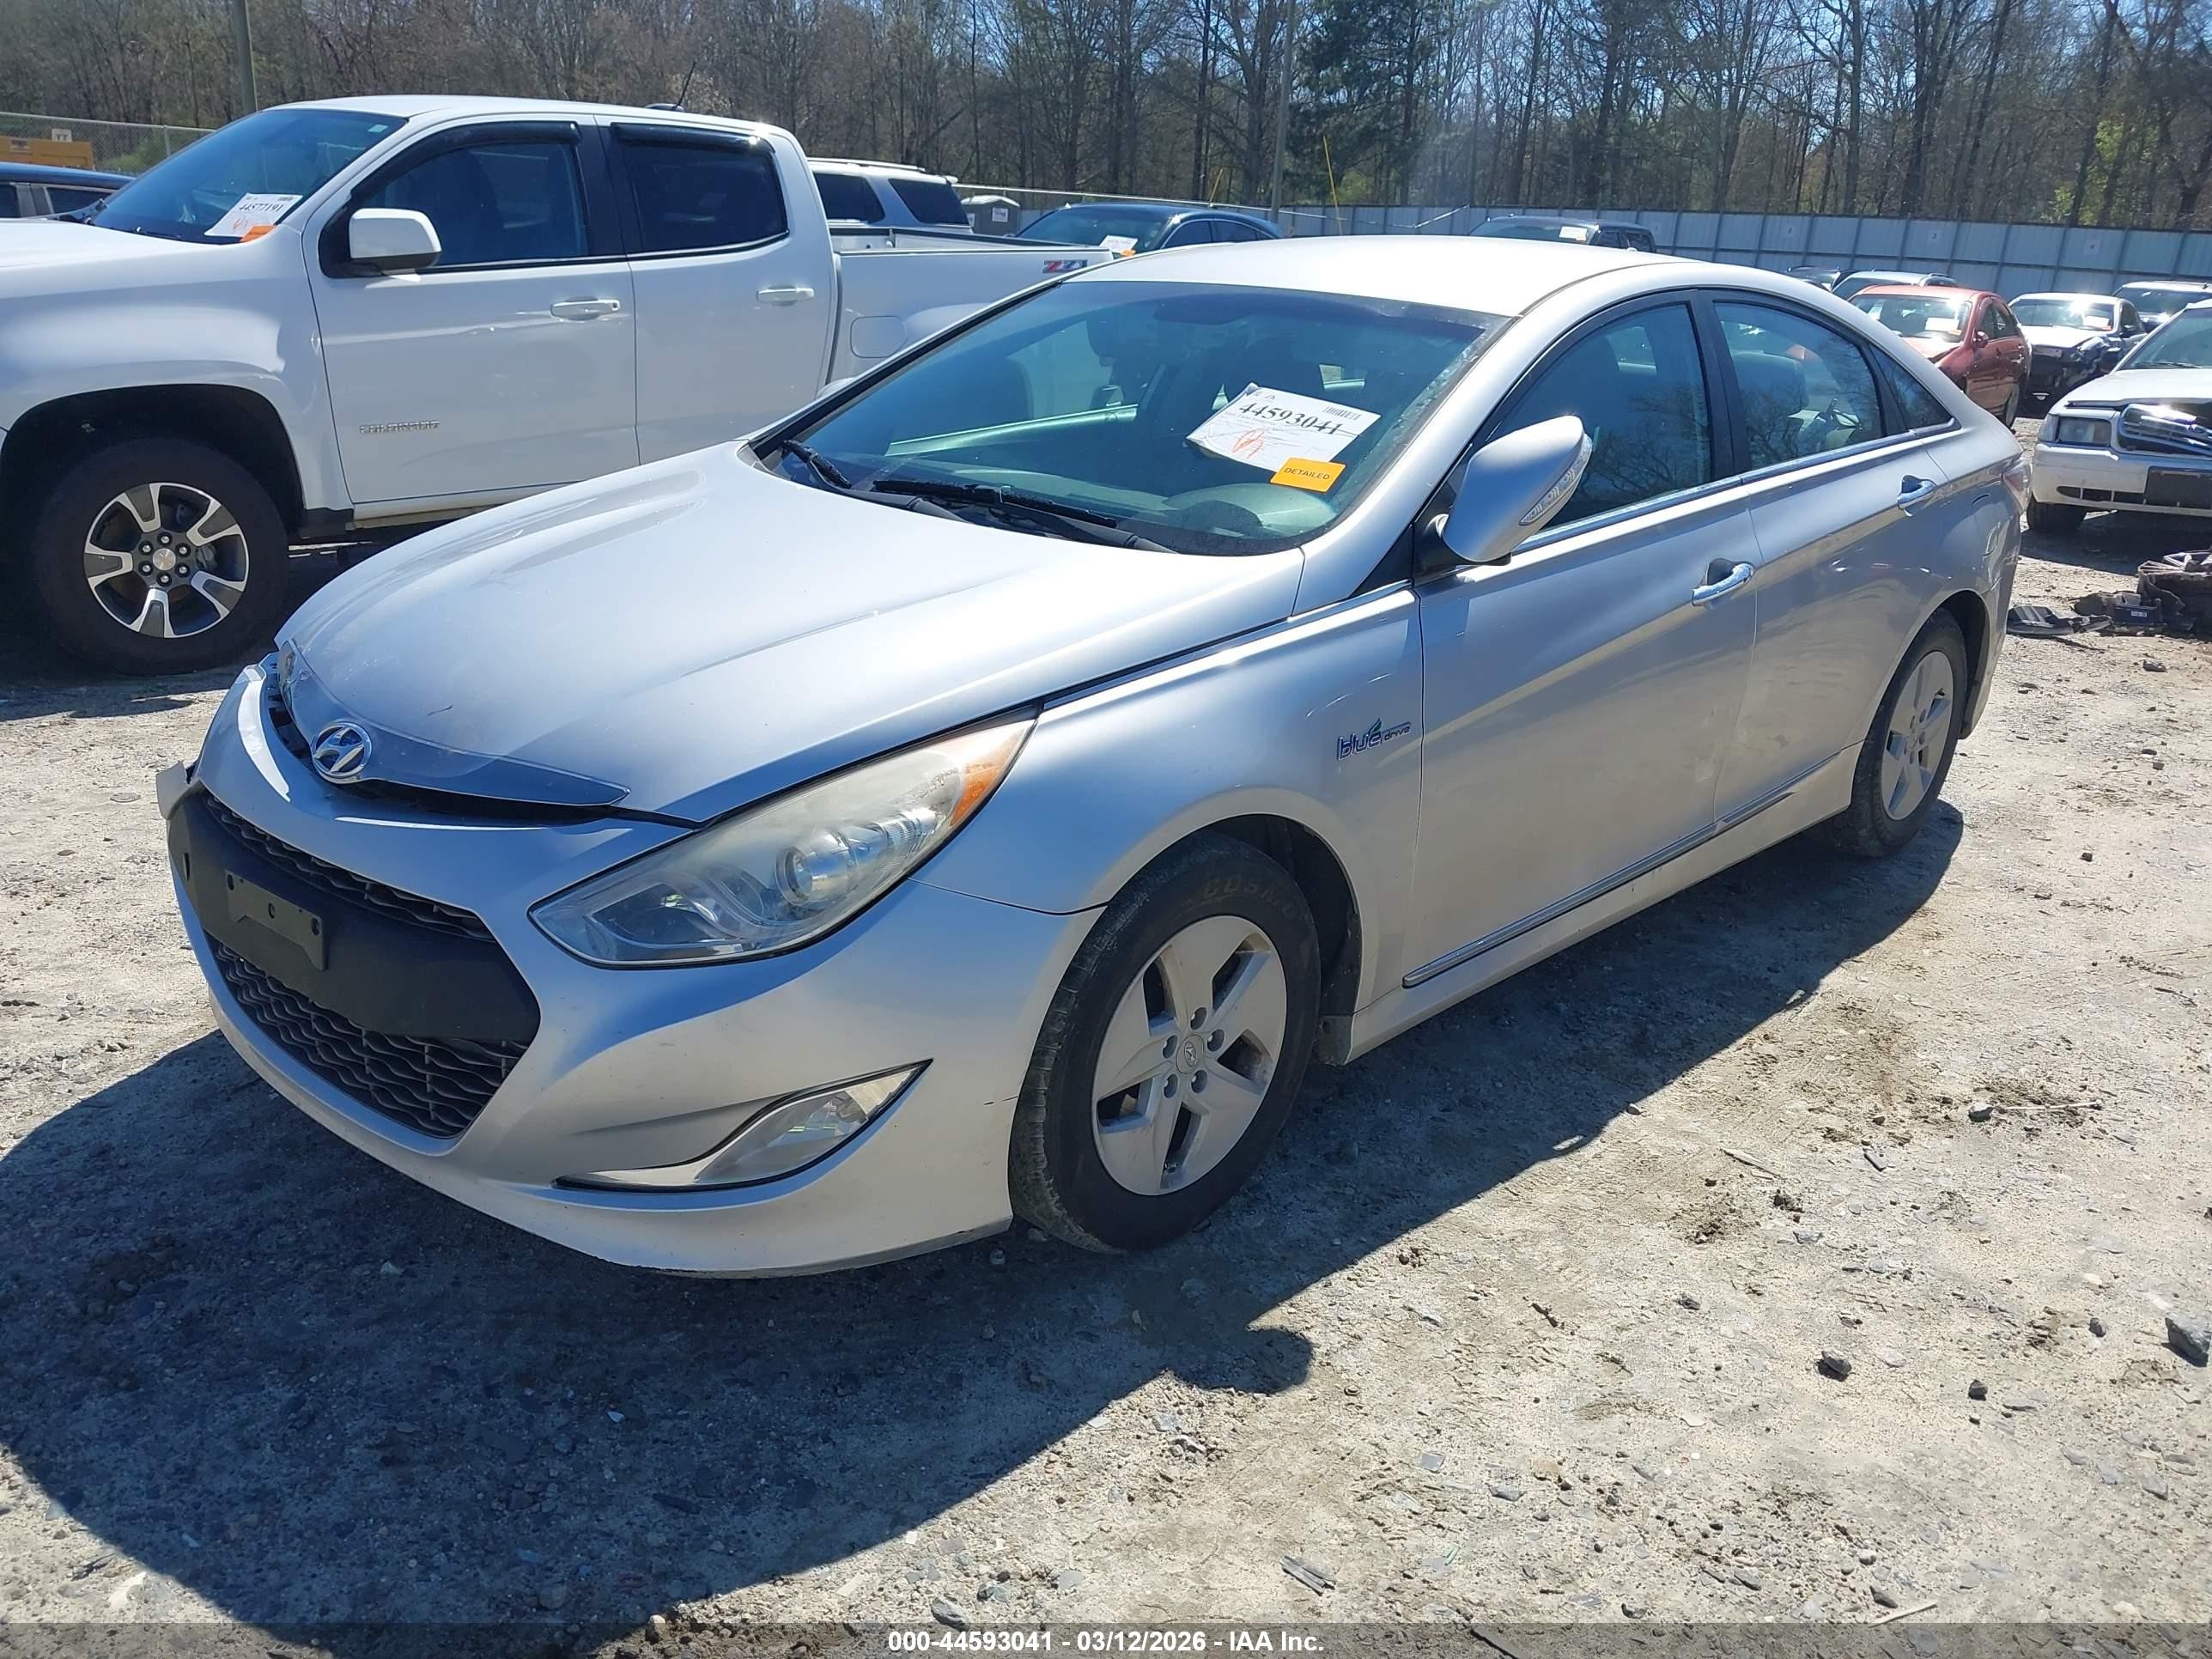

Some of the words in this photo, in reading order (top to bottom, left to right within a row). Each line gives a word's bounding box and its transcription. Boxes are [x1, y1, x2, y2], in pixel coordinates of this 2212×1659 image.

[1239, 401, 1345, 435] 44593041
[1284, 465, 1332, 481] DETAILED
[1337, 729, 1382, 761] blue
